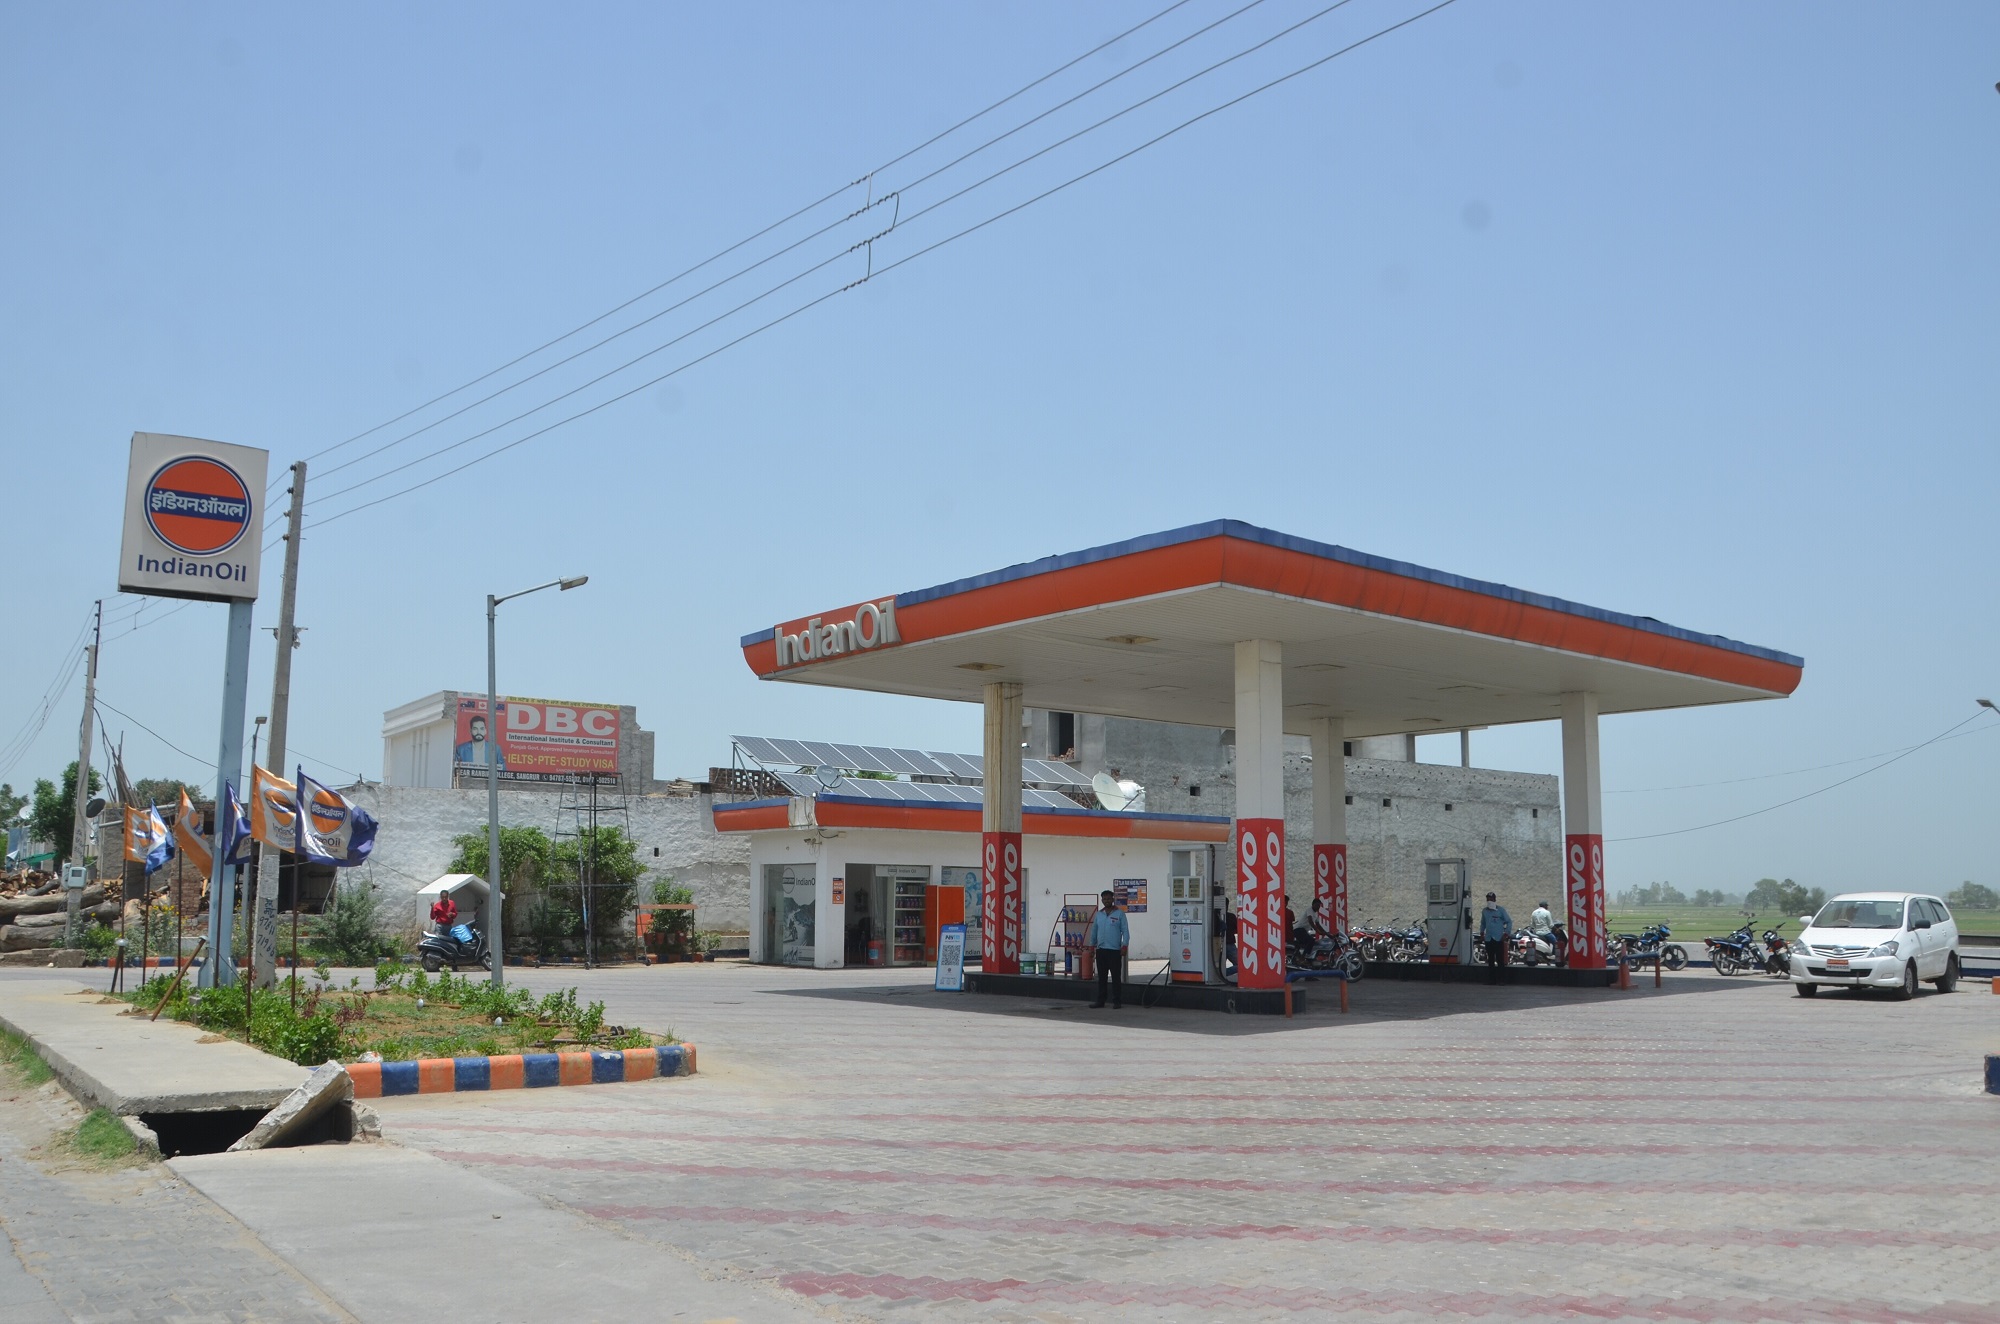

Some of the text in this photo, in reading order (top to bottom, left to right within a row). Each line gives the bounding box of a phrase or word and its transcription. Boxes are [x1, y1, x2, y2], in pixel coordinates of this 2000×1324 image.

[151, 491, 245, 517] इंडियनऑयल
[137, 554, 247, 582] IndianOil
[775, 599, 899, 667] IndianOil
[506, 703, 615, 736] DBC
[508, 734, 548, 742] International
[549, 736, 574, 744] Institute
[582, 738, 613, 746] Consultant
[592, 758, 614, 769] VISA
[985, 842, 997, 962] SERVO
[1003, 842, 1018, 963] SERVO
[1241, 831, 1258, 976] SERVO
[1266, 831, 1282, 976] SERVO
[1317, 853, 1330, 934] ERVO
[1335, 853, 1346, 934] ERVO
[1570, 843, 1588, 957] SERVO
[1592, 844, 1604, 957] SERVO
